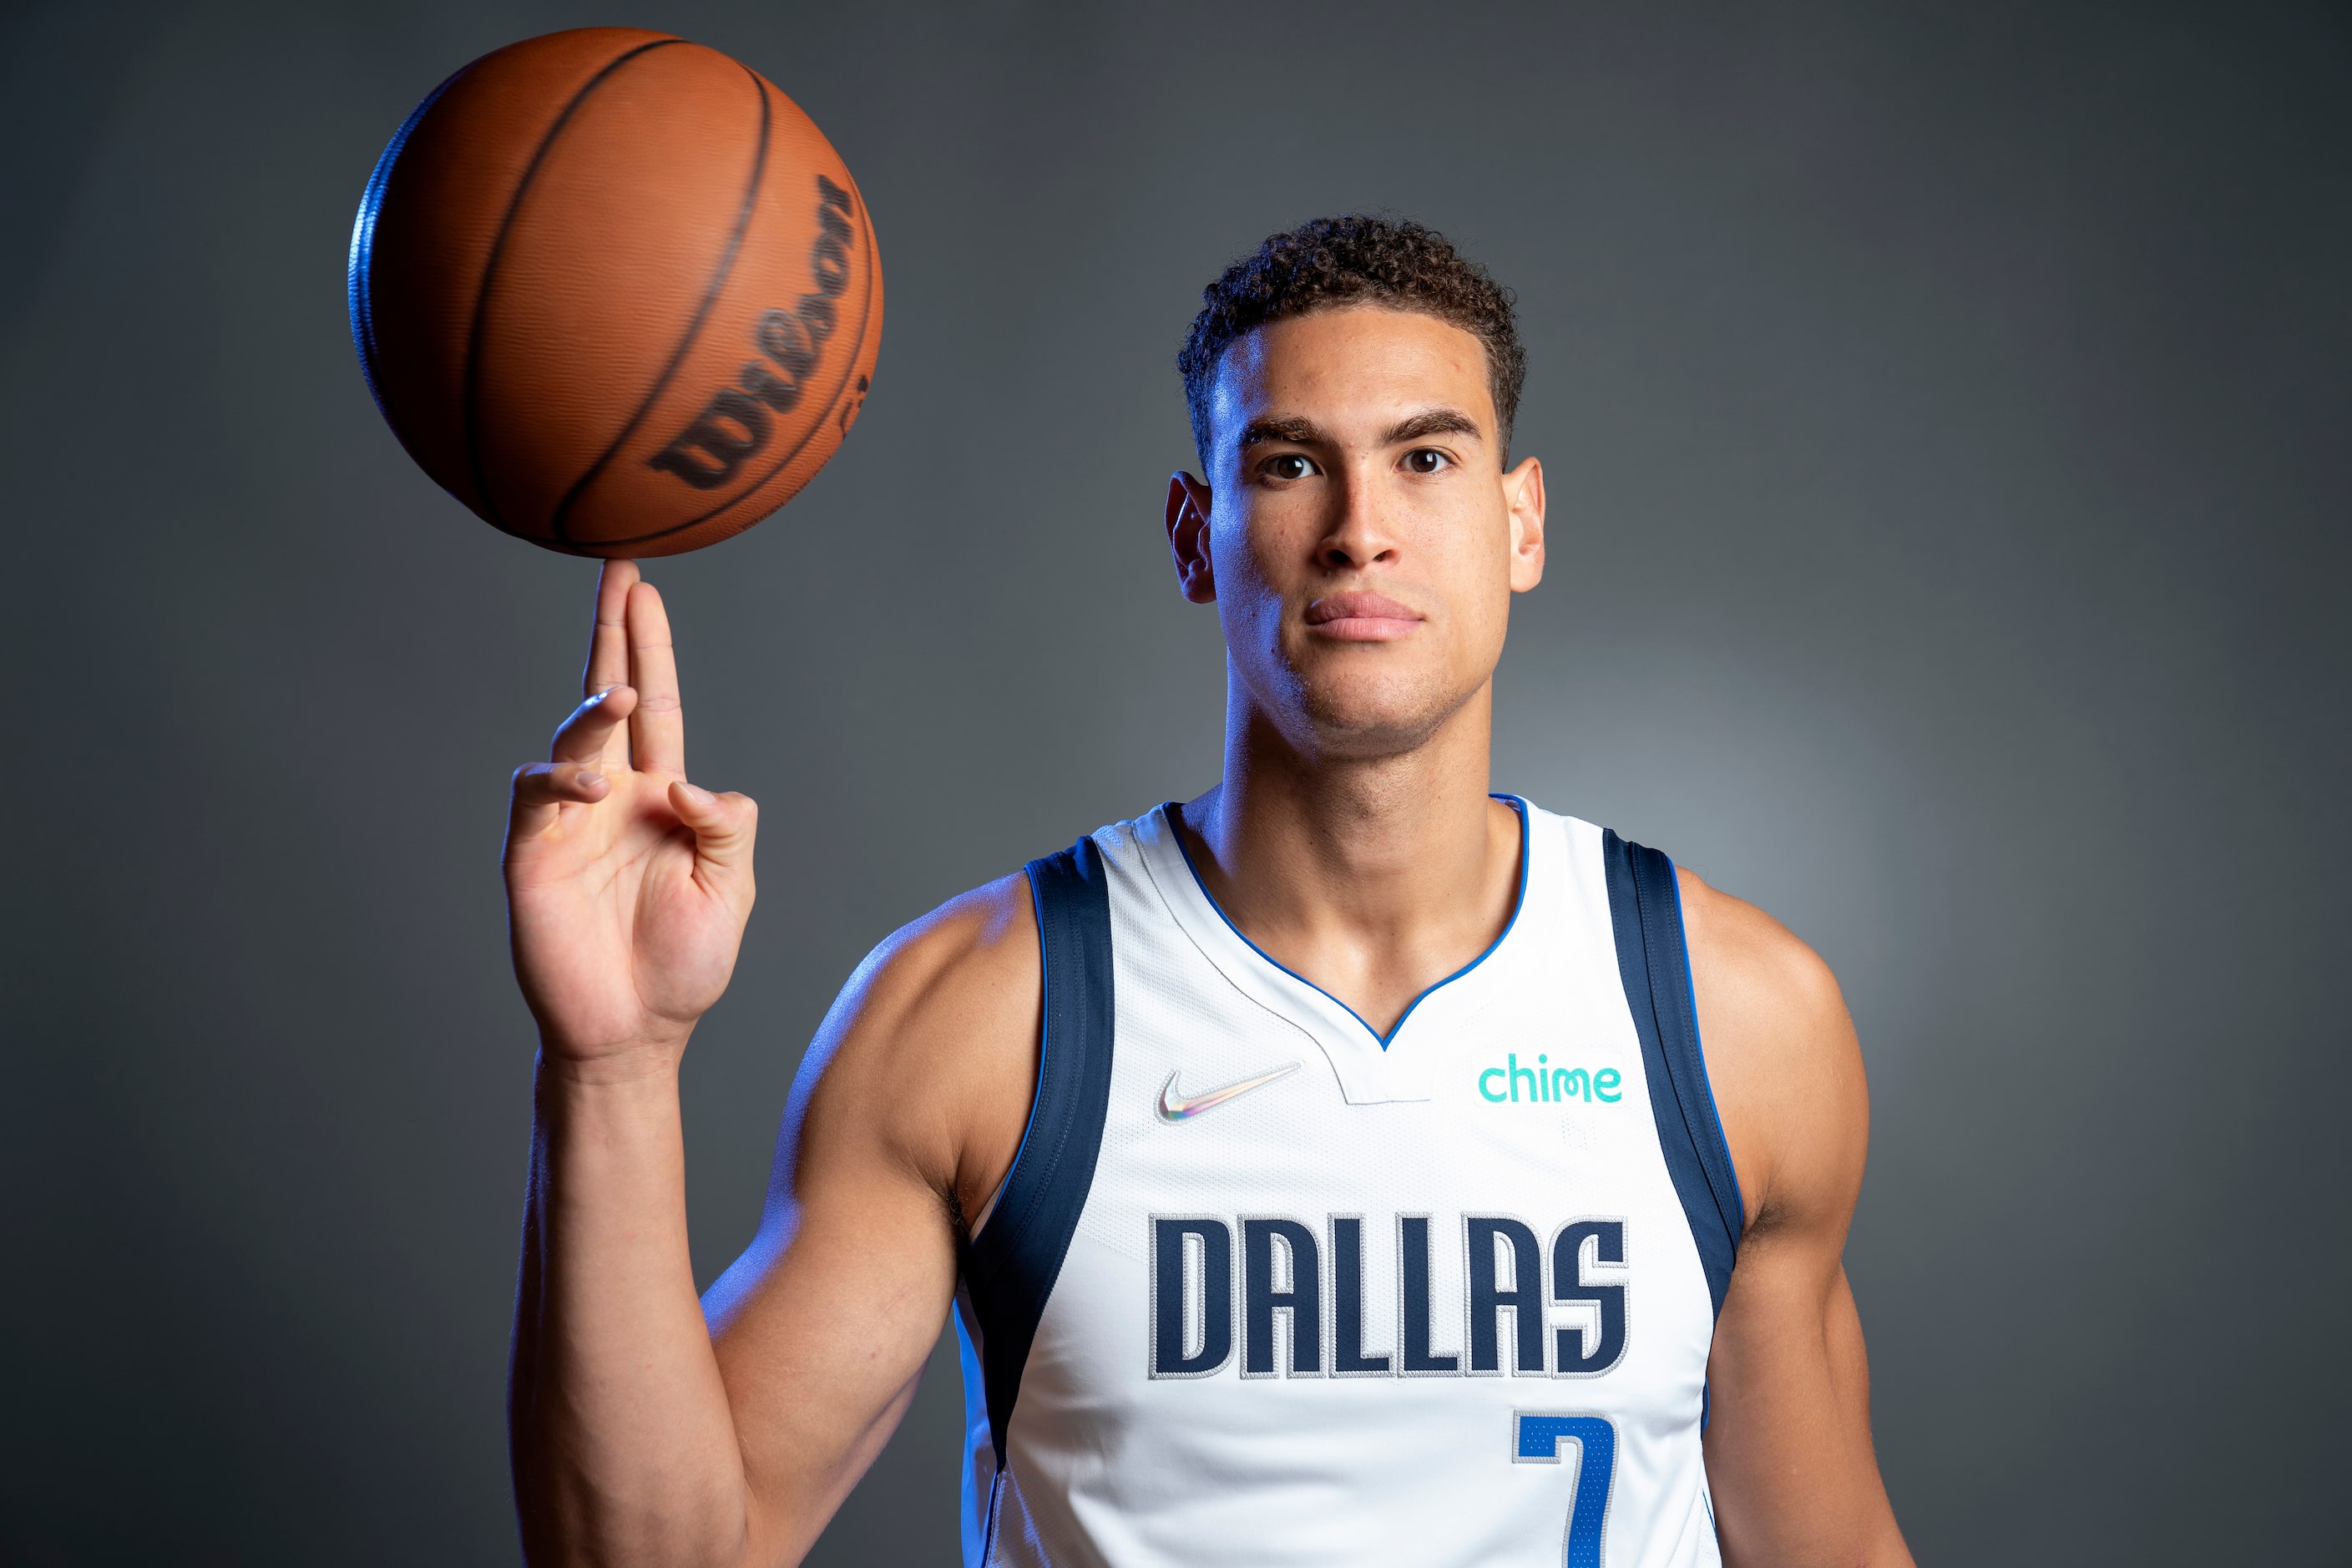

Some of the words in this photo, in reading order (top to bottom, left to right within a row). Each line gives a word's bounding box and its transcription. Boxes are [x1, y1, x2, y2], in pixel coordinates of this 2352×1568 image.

[650, 175, 853, 489] Wilson
[1478, 1053, 1622, 1103] chime
[1148, 1212, 1631, 1380] DALLAS
[1512, 1409, 1620, 1568] 7
